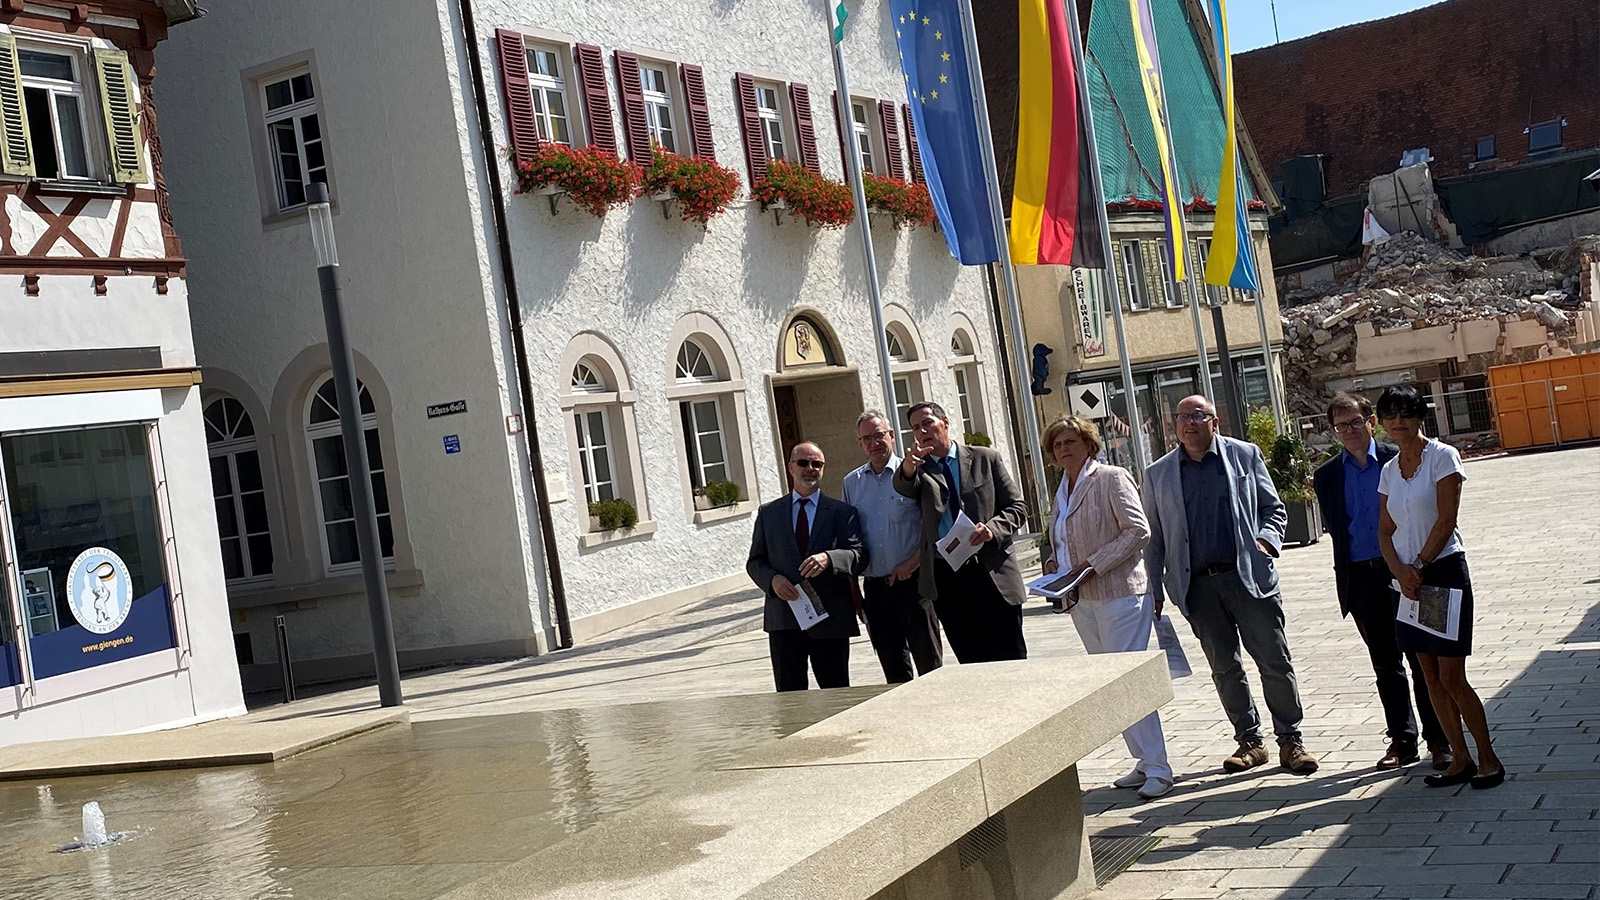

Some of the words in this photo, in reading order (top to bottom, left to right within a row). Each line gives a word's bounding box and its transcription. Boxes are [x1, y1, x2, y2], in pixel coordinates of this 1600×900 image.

[1075, 270, 1092, 339] SCHREIBWAREN
[68, 553, 88, 595] HAUPTSTADT
[72, 608, 96, 632] GIENGEN
[108, 622, 120, 631] DER
[120, 599, 131, 621] BRENZ
[81, 635, 134, 653] www.giengen.de
